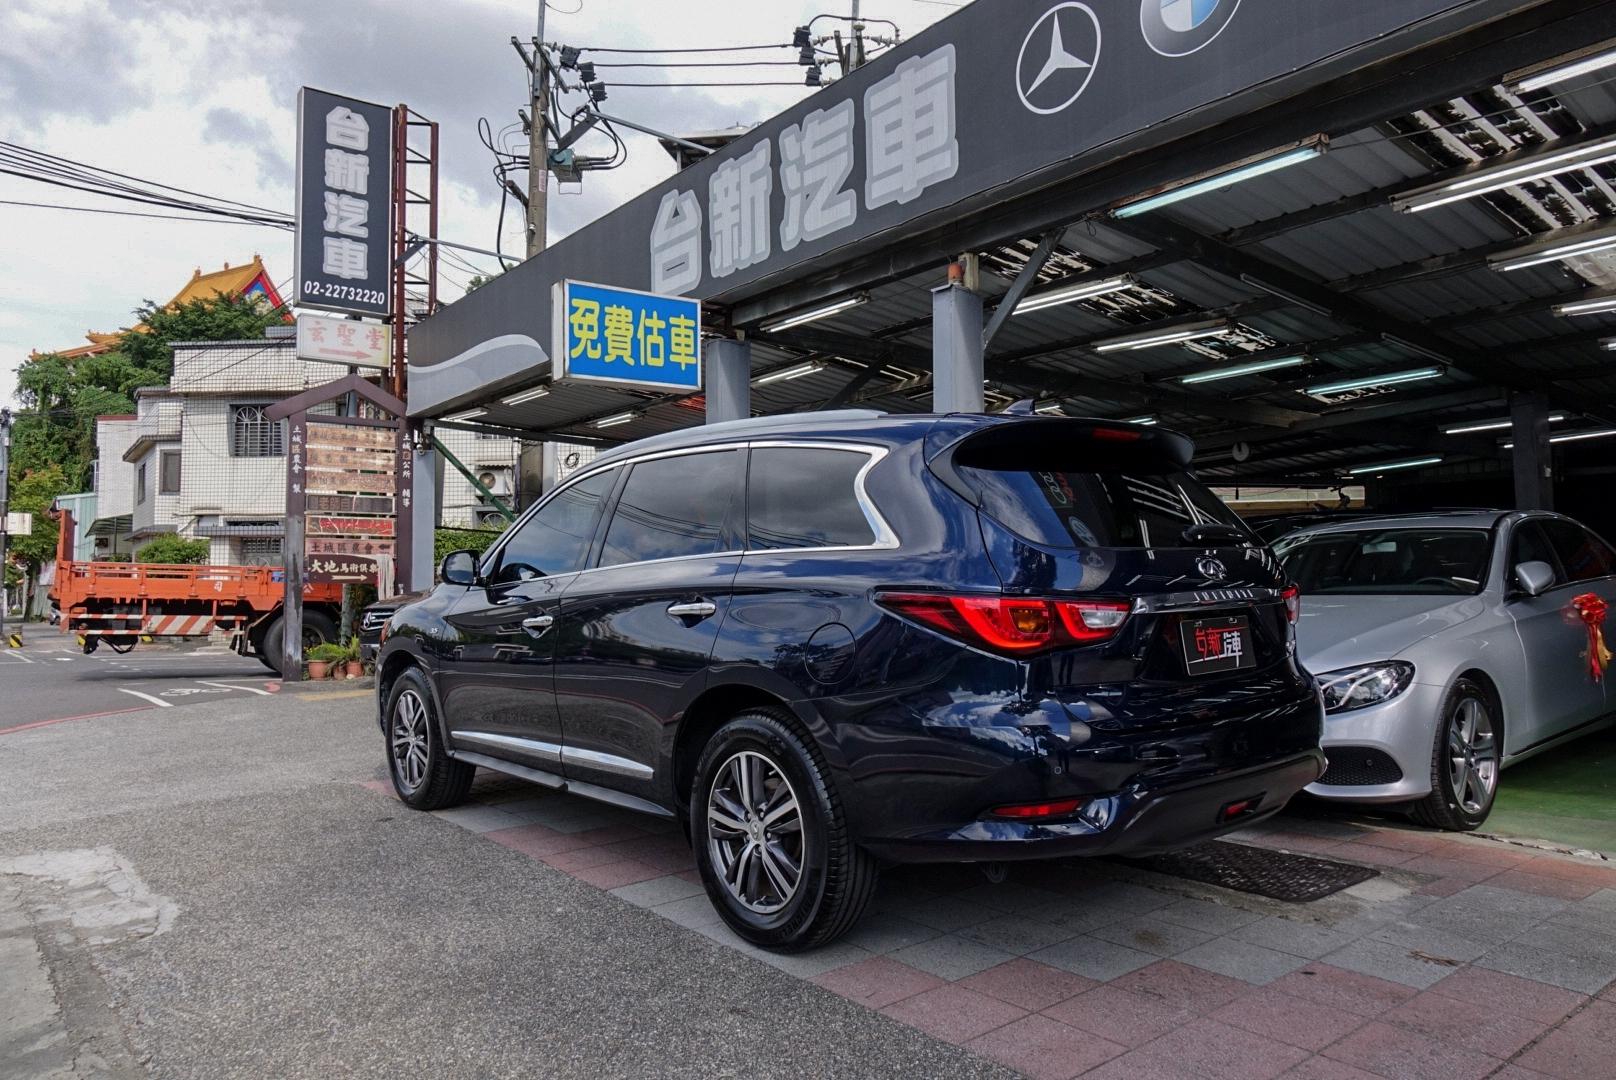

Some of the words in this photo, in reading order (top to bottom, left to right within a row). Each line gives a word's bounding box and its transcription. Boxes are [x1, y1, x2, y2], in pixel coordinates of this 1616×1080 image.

[323, 106, 369, 280] 台新汽車
[651, 43, 958, 297] 台新汽車
[304, 280, 385, 305] 02-22732220
[570, 298, 697, 371] 免費估車
